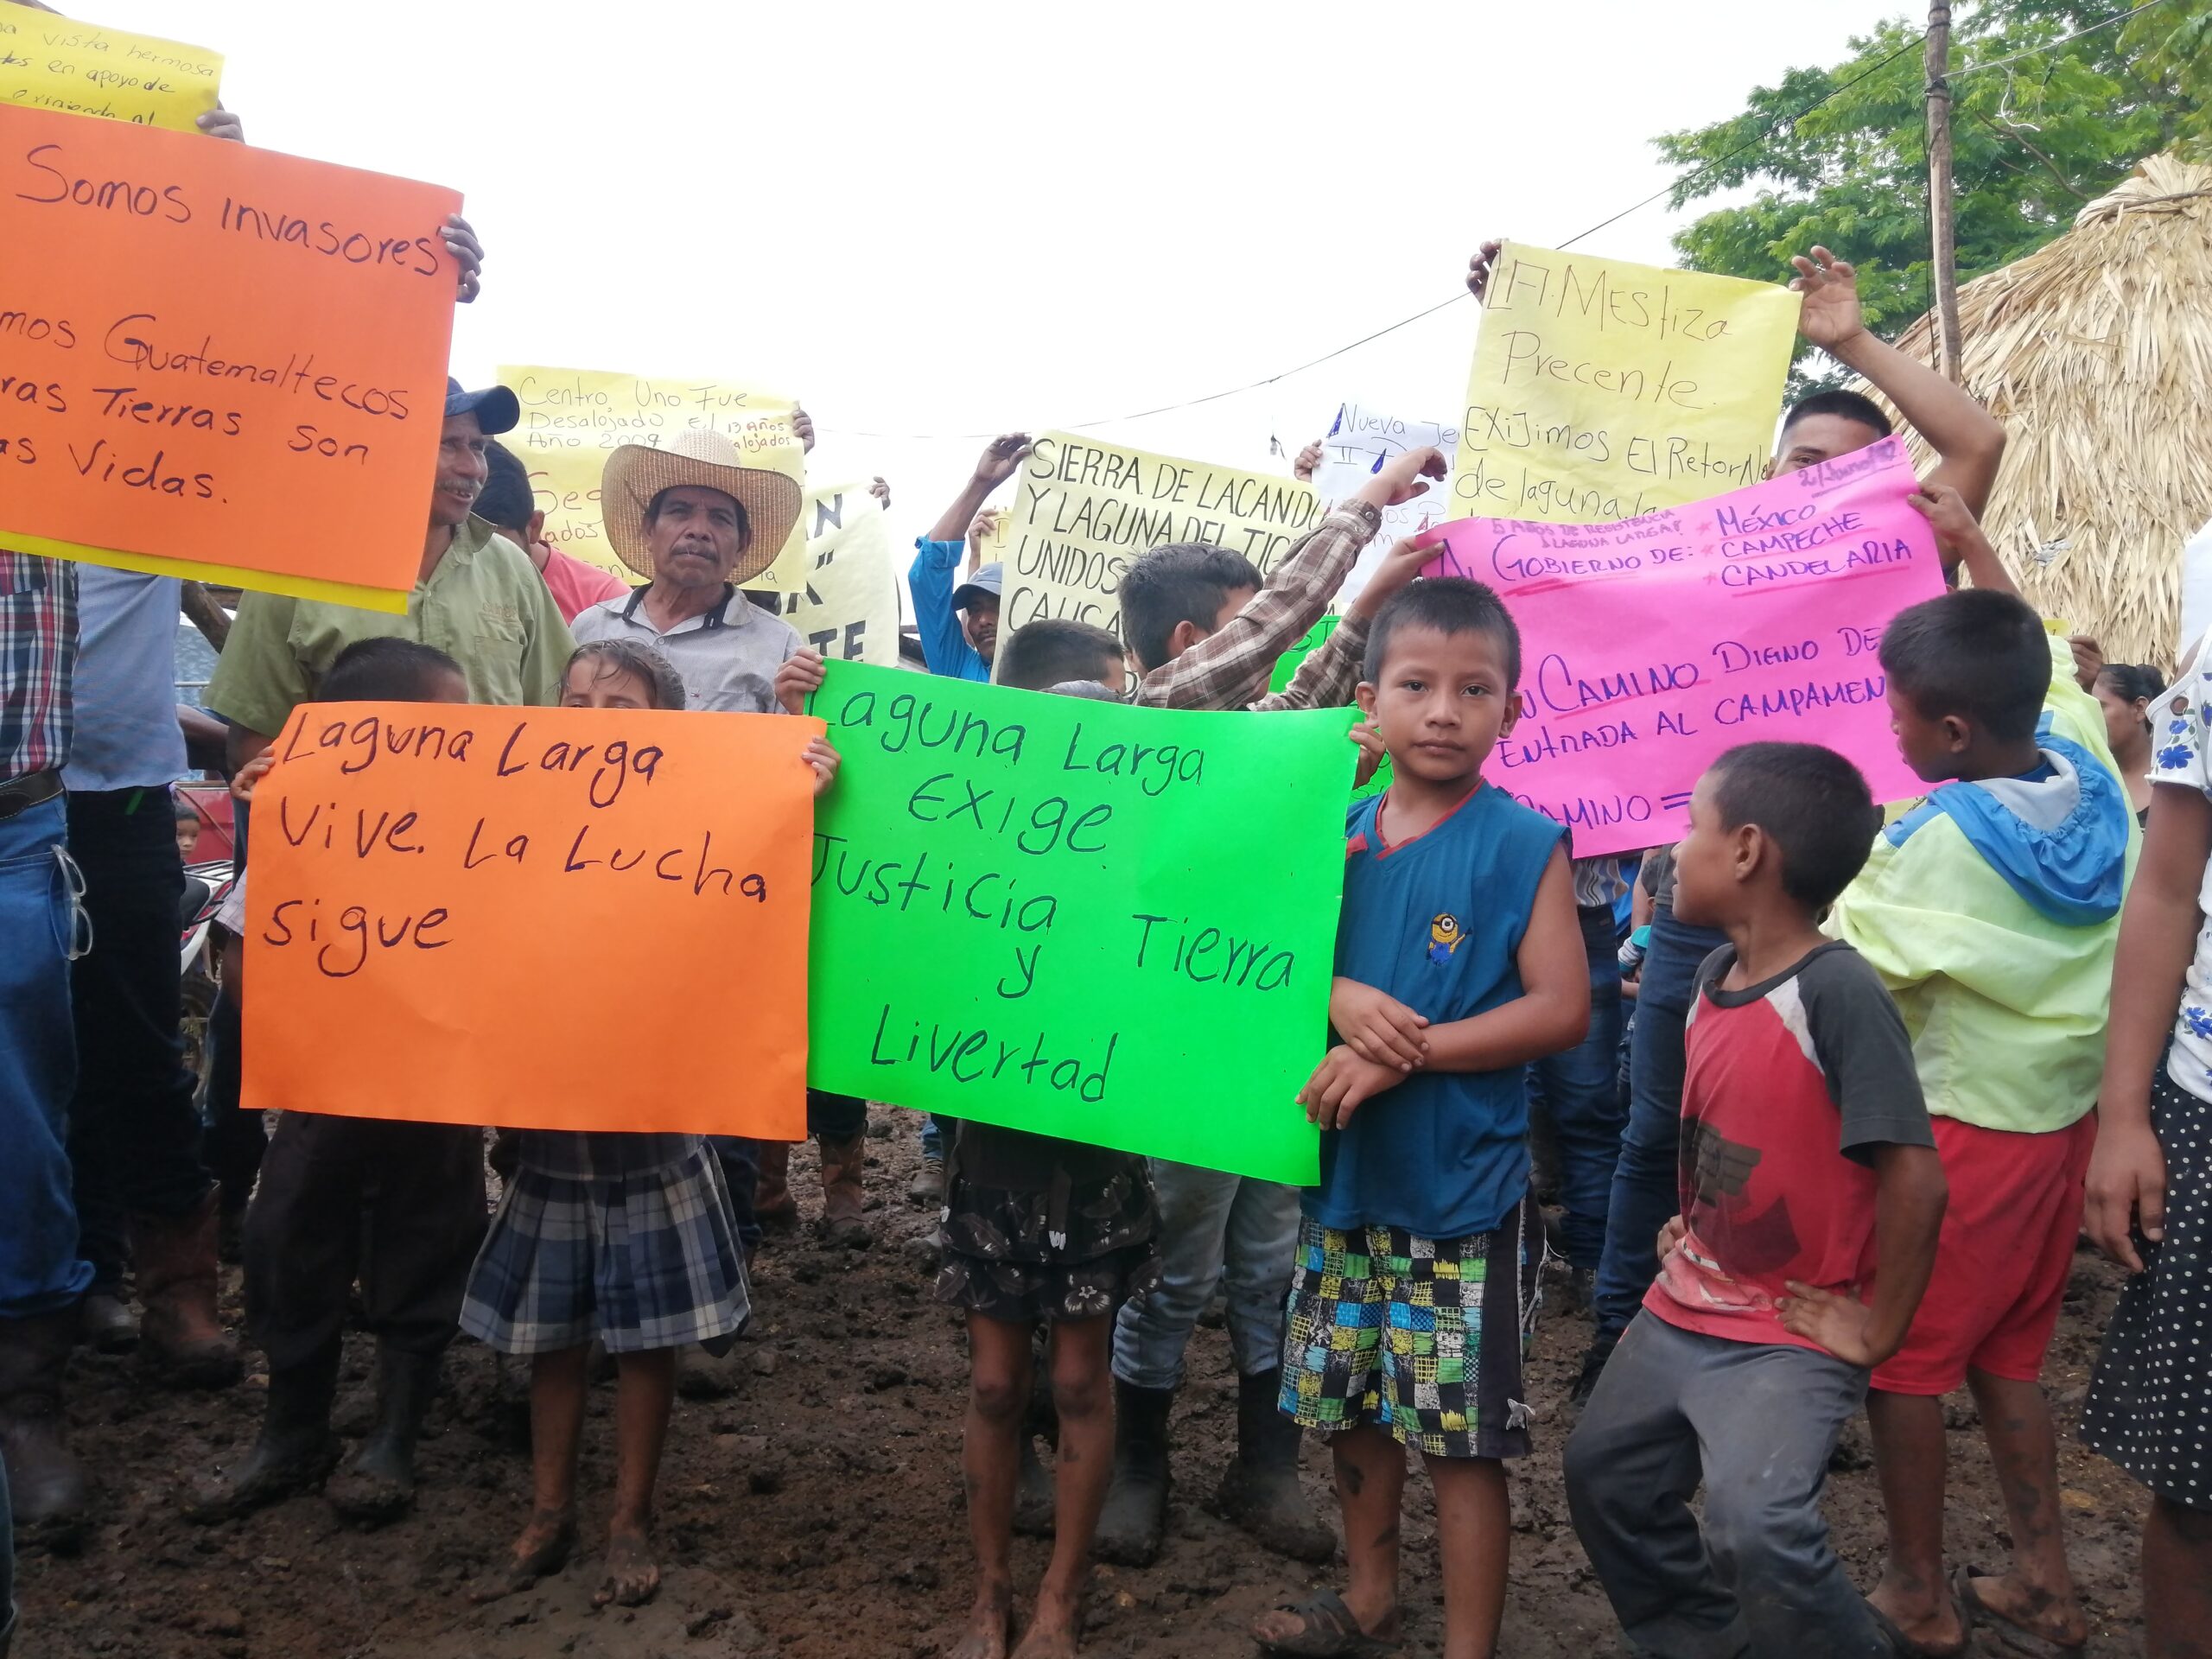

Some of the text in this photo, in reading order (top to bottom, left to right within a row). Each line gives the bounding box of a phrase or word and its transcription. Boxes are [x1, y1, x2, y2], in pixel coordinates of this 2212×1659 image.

[48, 60, 75, 74] en
[86, 69, 138, 88] apoyo
[143, 77, 175, 92] de
[127, 44, 213, 77] hermosa
[16, 145, 191, 223] Somos
[104, 314, 409, 420] Guatemaltecos
[92, 387, 242, 436] Tierras
[519, 376, 747, 410] Centro Uno Fue
[526, 432, 582, 448] Año
[529, 407, 664, 432] Desalojado
[1326, 403, 1406, 439] Nueva
[67, 439, 228, 504] Vidas.
[1153, 463, 1194, 503] DE
[1455, 458, 1510, 501] de
[1027, 483, 1051, 525] Y
[1053, 492, 1173, 548] LAGUNA
[1716, 504, 1817, 537] MÉXICO
[1721, 512, 1864, 559] CAMPECHE
[1492, 534, 1642, 582] GOBIERNO
[1721, 537, 1912, 588] CANDELARIA
[1538, 654, 1700, 712] CAMINO
[1656, 710, 1698, 737] AL
[283, 712, 664, 808] Laguna Larga
[1064, 722, 1205, 796] Larga
[465, 817, 529, 869] La
[565, 824, 766, 903] Lucha
[1132, 914, 1296, 991] Tierra
[871, 1004, 1119, 1103] Livertad
